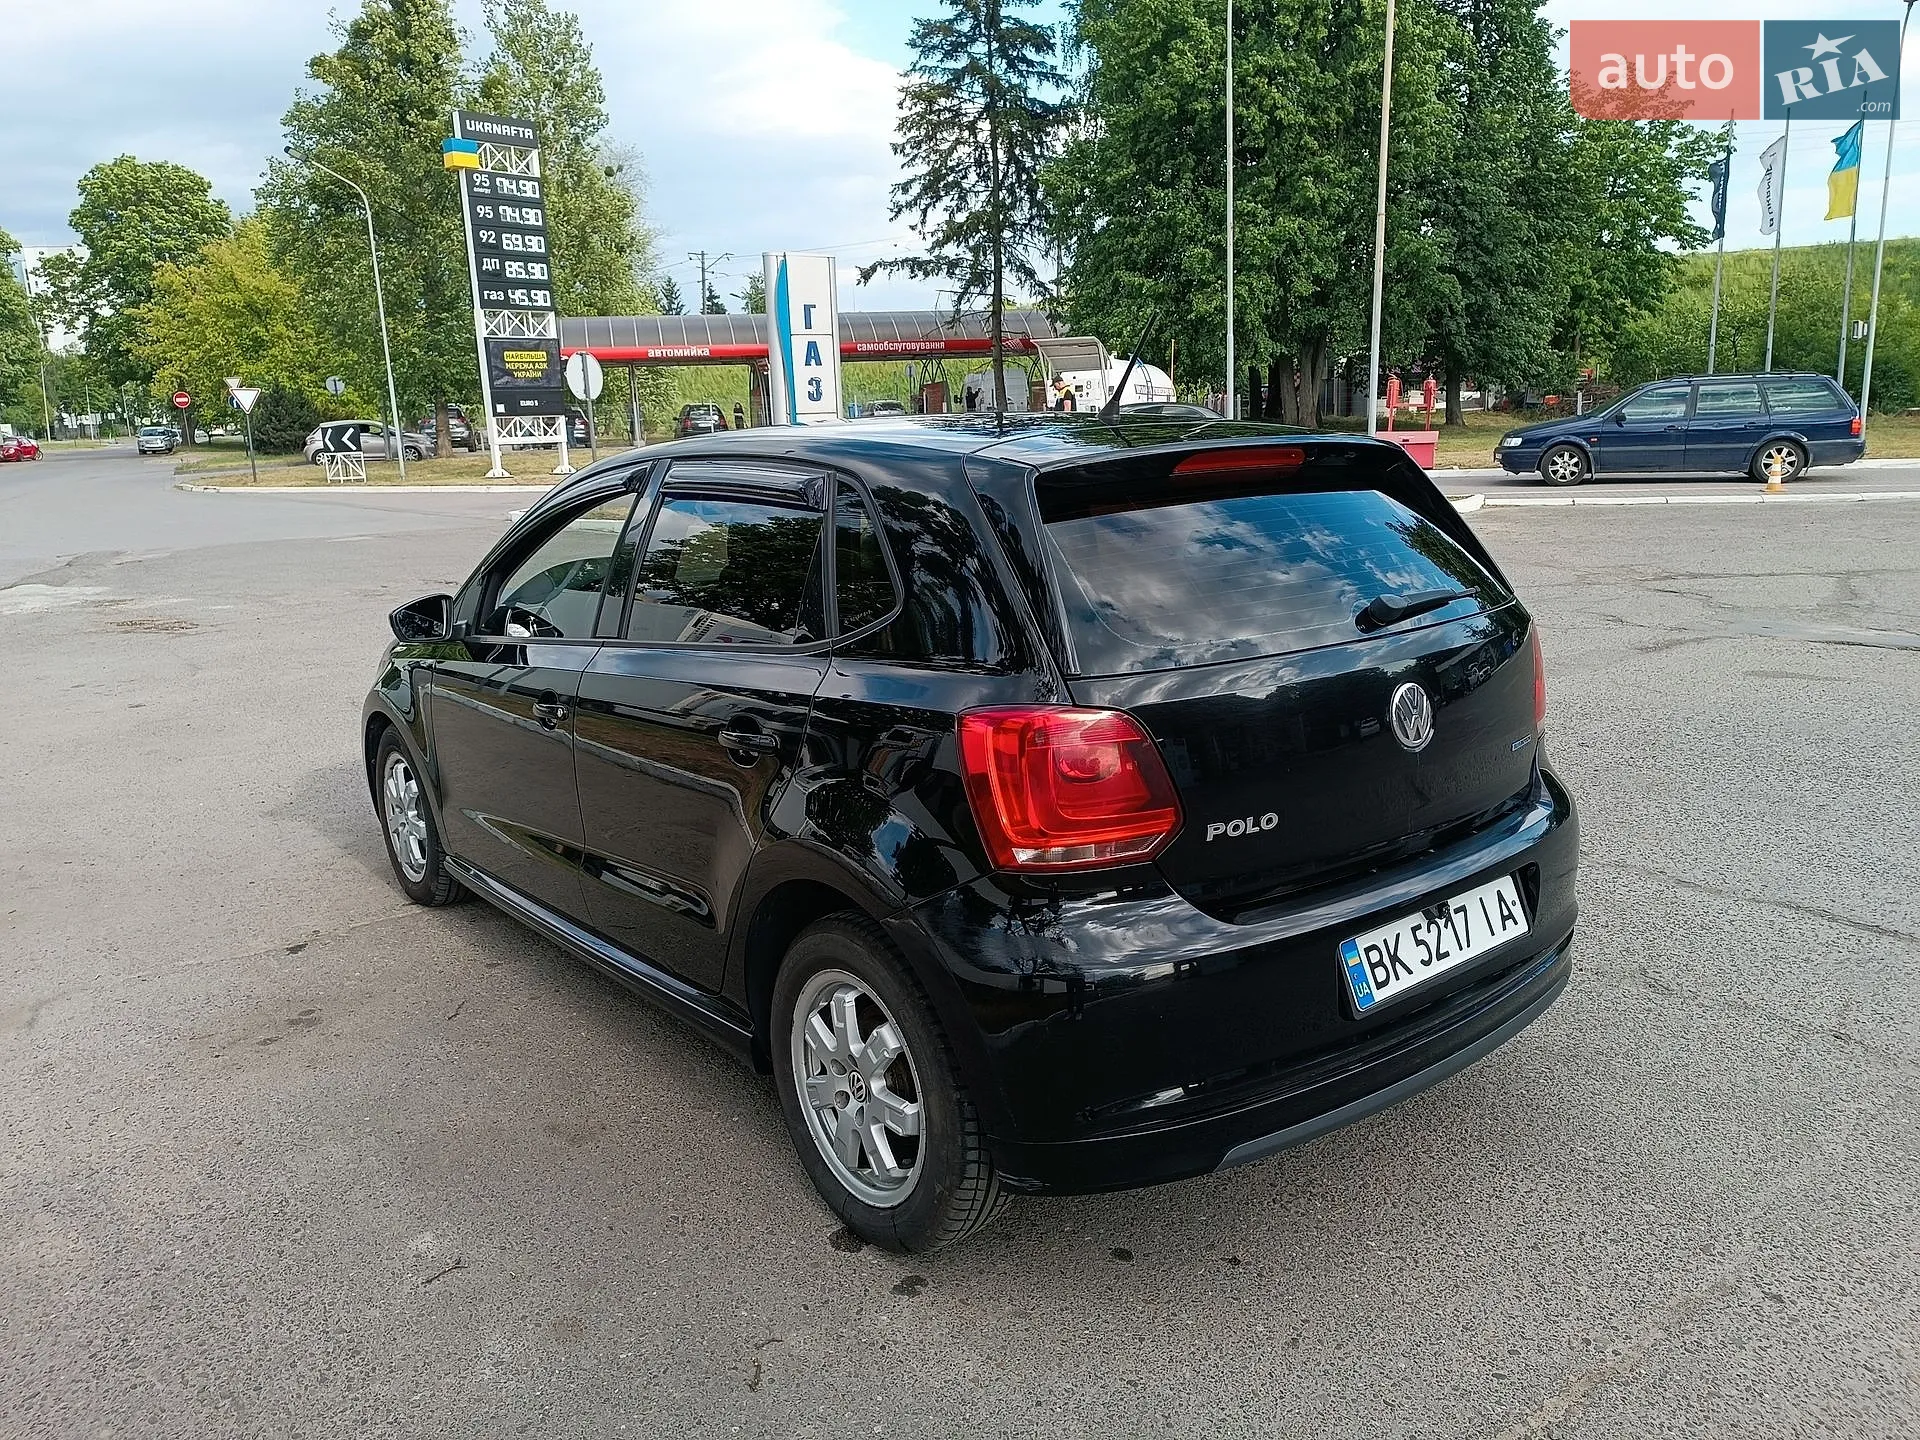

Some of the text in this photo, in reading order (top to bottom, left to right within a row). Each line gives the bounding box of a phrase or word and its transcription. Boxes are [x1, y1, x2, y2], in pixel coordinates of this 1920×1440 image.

[466, 120, 533, 139] UKRNAFTA
[473, 173, 490, 186] 95
[476, 205, 493, 219] 95
[479, 230, 545, 253] 92 69.90
[482, 258, 548, 280] ДП 85.90
[483, 289, 551, 307] газ 45.90
[648, 346, 710, 357] автомийка
[857, 341, 945, 352] самообслуговування
[513, 370, 542, 378] УКРАЇНИ
[1206, 813, 1278, 841] POLO
[1363, 932, 1413, 990] BK
[1411, 904, 1471, 966] 5217
[1355, 981, 1371, 997] UA
